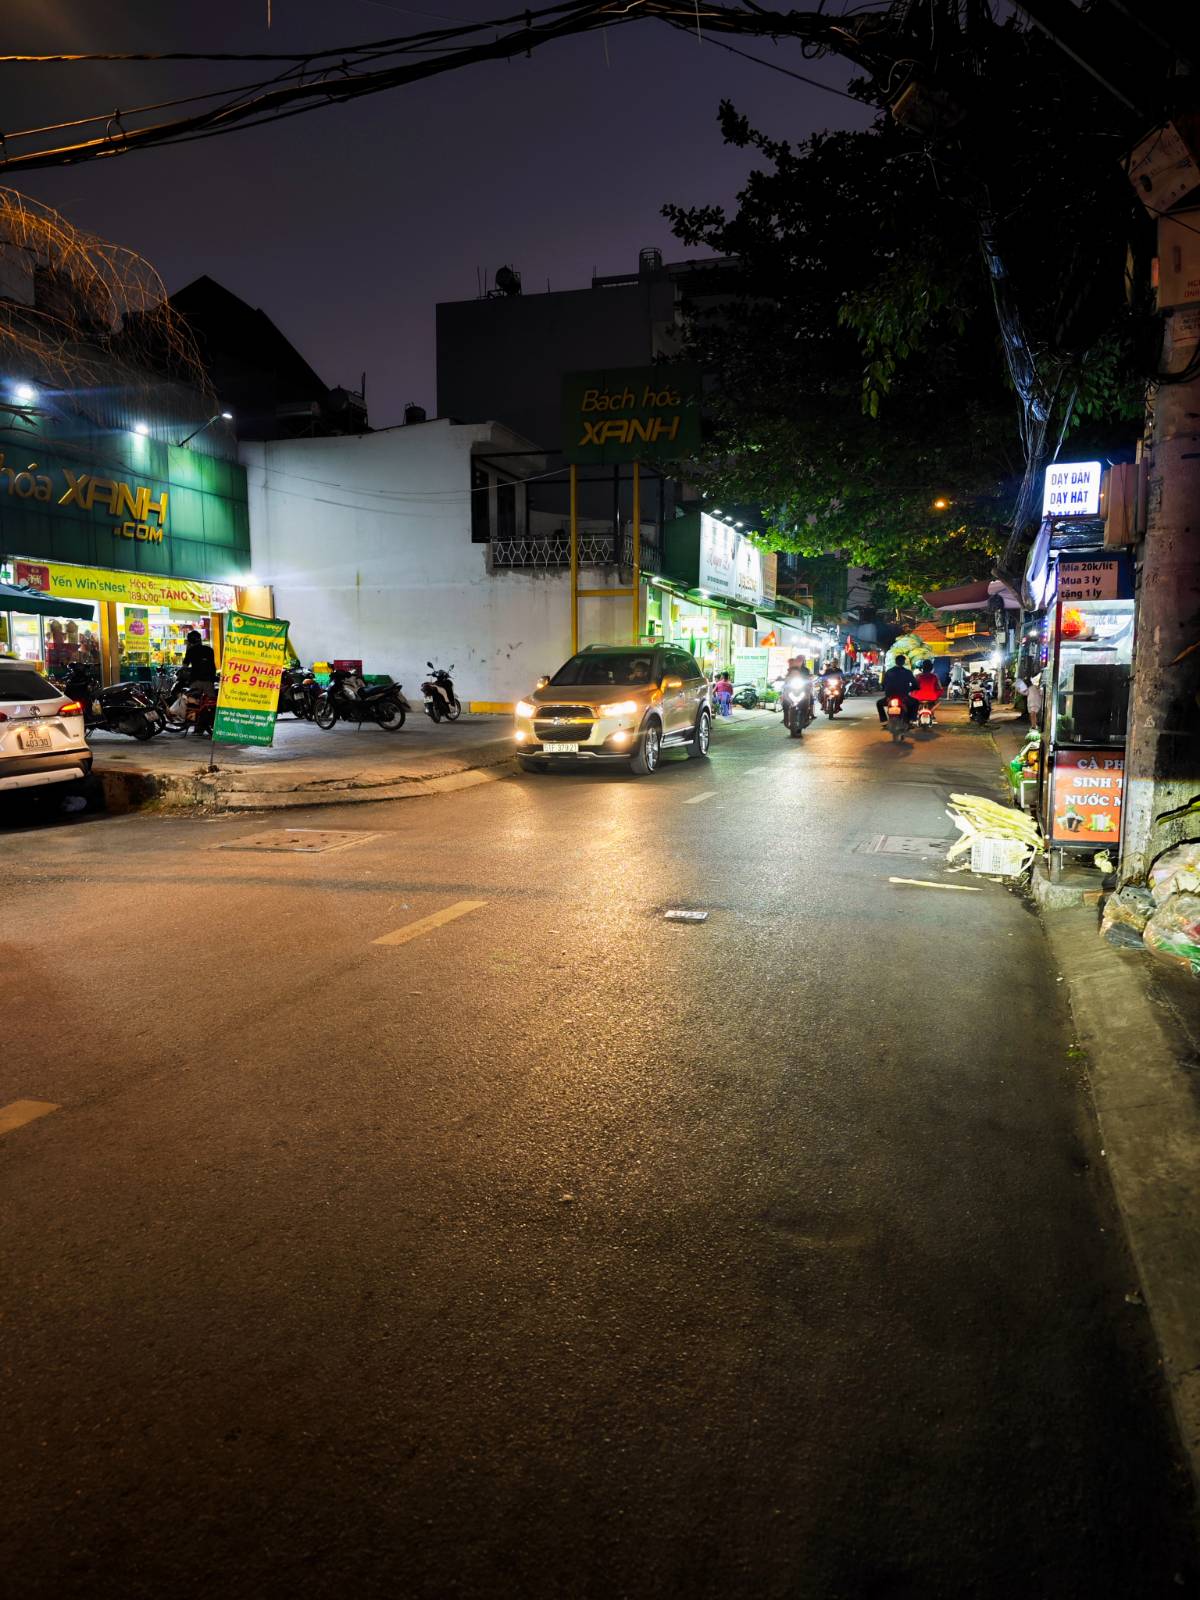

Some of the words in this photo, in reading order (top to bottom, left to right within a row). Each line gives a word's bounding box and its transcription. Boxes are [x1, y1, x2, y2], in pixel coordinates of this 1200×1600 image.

[578, 415, 681, 446] XANH
[58, 469, 169, 524] XANH
[1061, 577, 1082, 585] Mua
[1084, 576, 1090, 584] 3
[1092, 575, 1101, 586] ly
[1085, 589, 1090, 597] 1
[1093, 589, 1102, 599] ly
[228, 661, 250, 673] THU
[232, 673, 240, 684] 6
[249, 675, 257, 686] 9
[1073, 776, 1112, 788] SINH
[1065, 793, 1110, 806] NƯỚC
